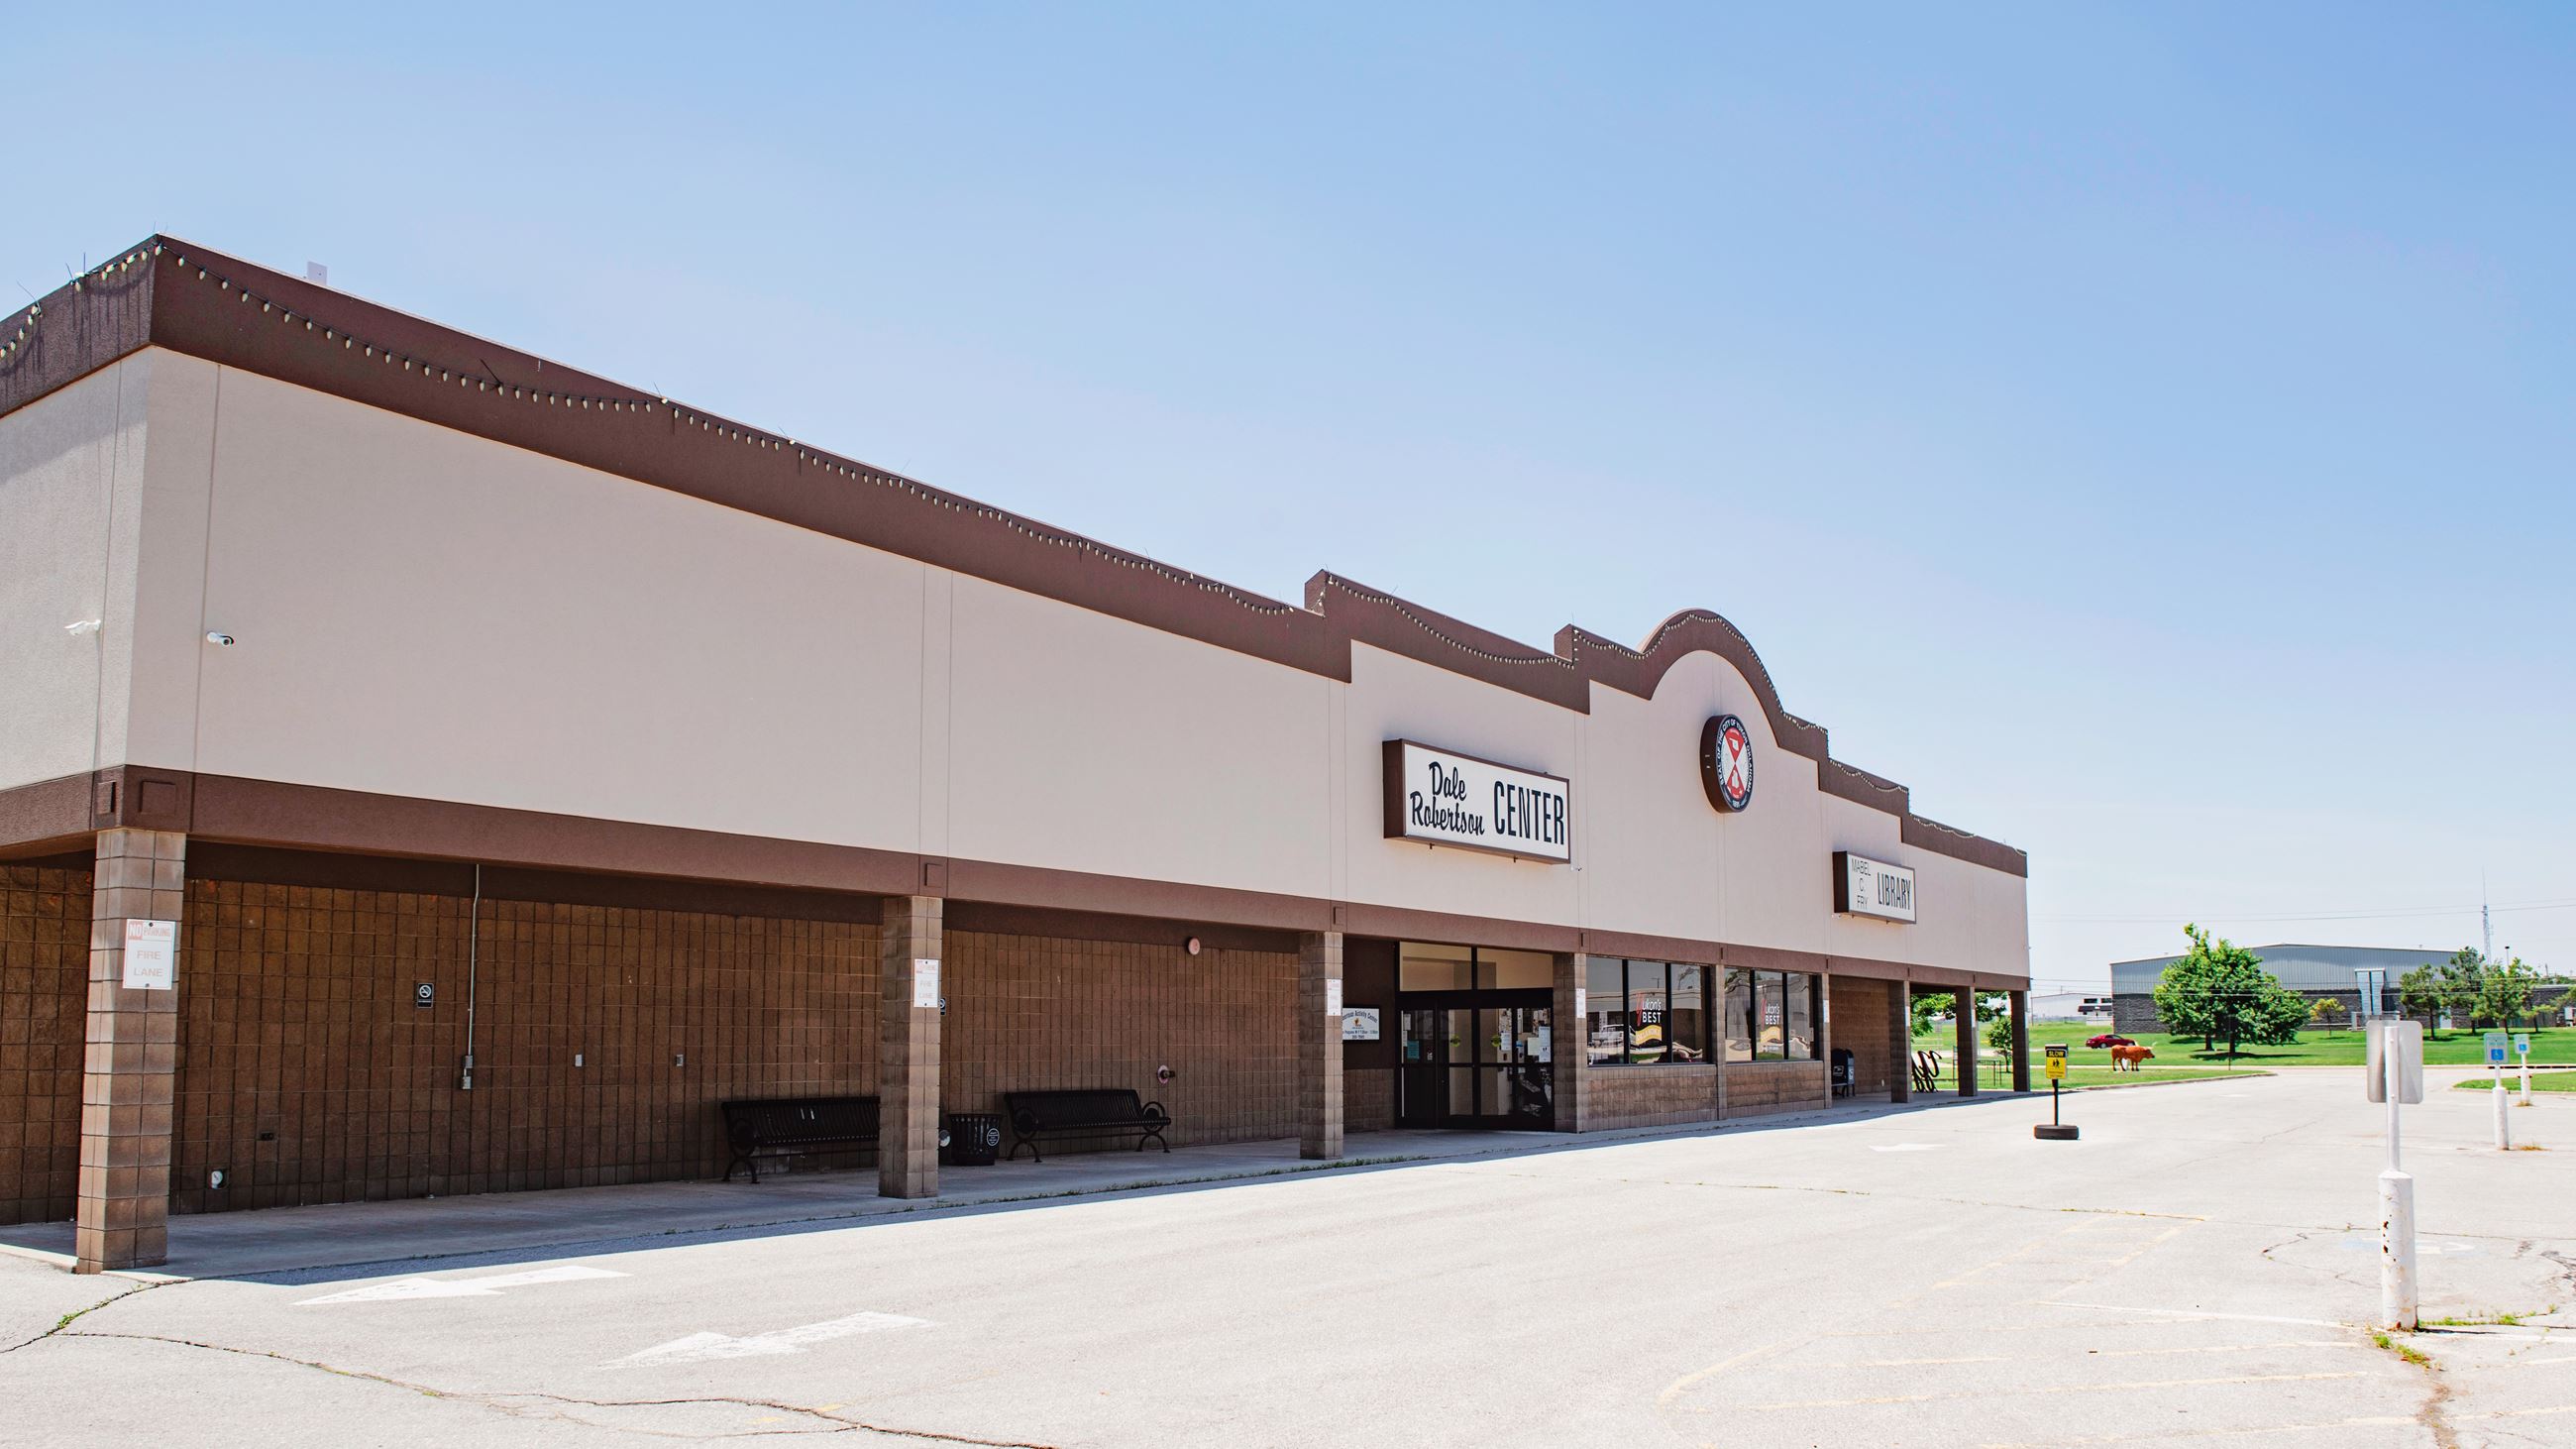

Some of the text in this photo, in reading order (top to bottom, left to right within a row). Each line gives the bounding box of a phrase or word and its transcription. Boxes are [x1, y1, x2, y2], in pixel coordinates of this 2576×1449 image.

[1428, 761, 1466, 801] Dale
[1410, 790, 1485, 836] Robertson
[1493, 781, 1564, 845] CENTER
[1851, 858, 1871, 876] MABEL
[1878, 872, 1911, 910] LIBRARY
[1857, 895, 1869, 910] FRY
[129, 924, 170, 937] NO PARKING
[137, 950, 161, 959] FIRE
[134, 967, 163, 977] LANE
[1642, 1011, 1662, 1023] BEST
[1765, 1014, 1779, 1025] BEST
